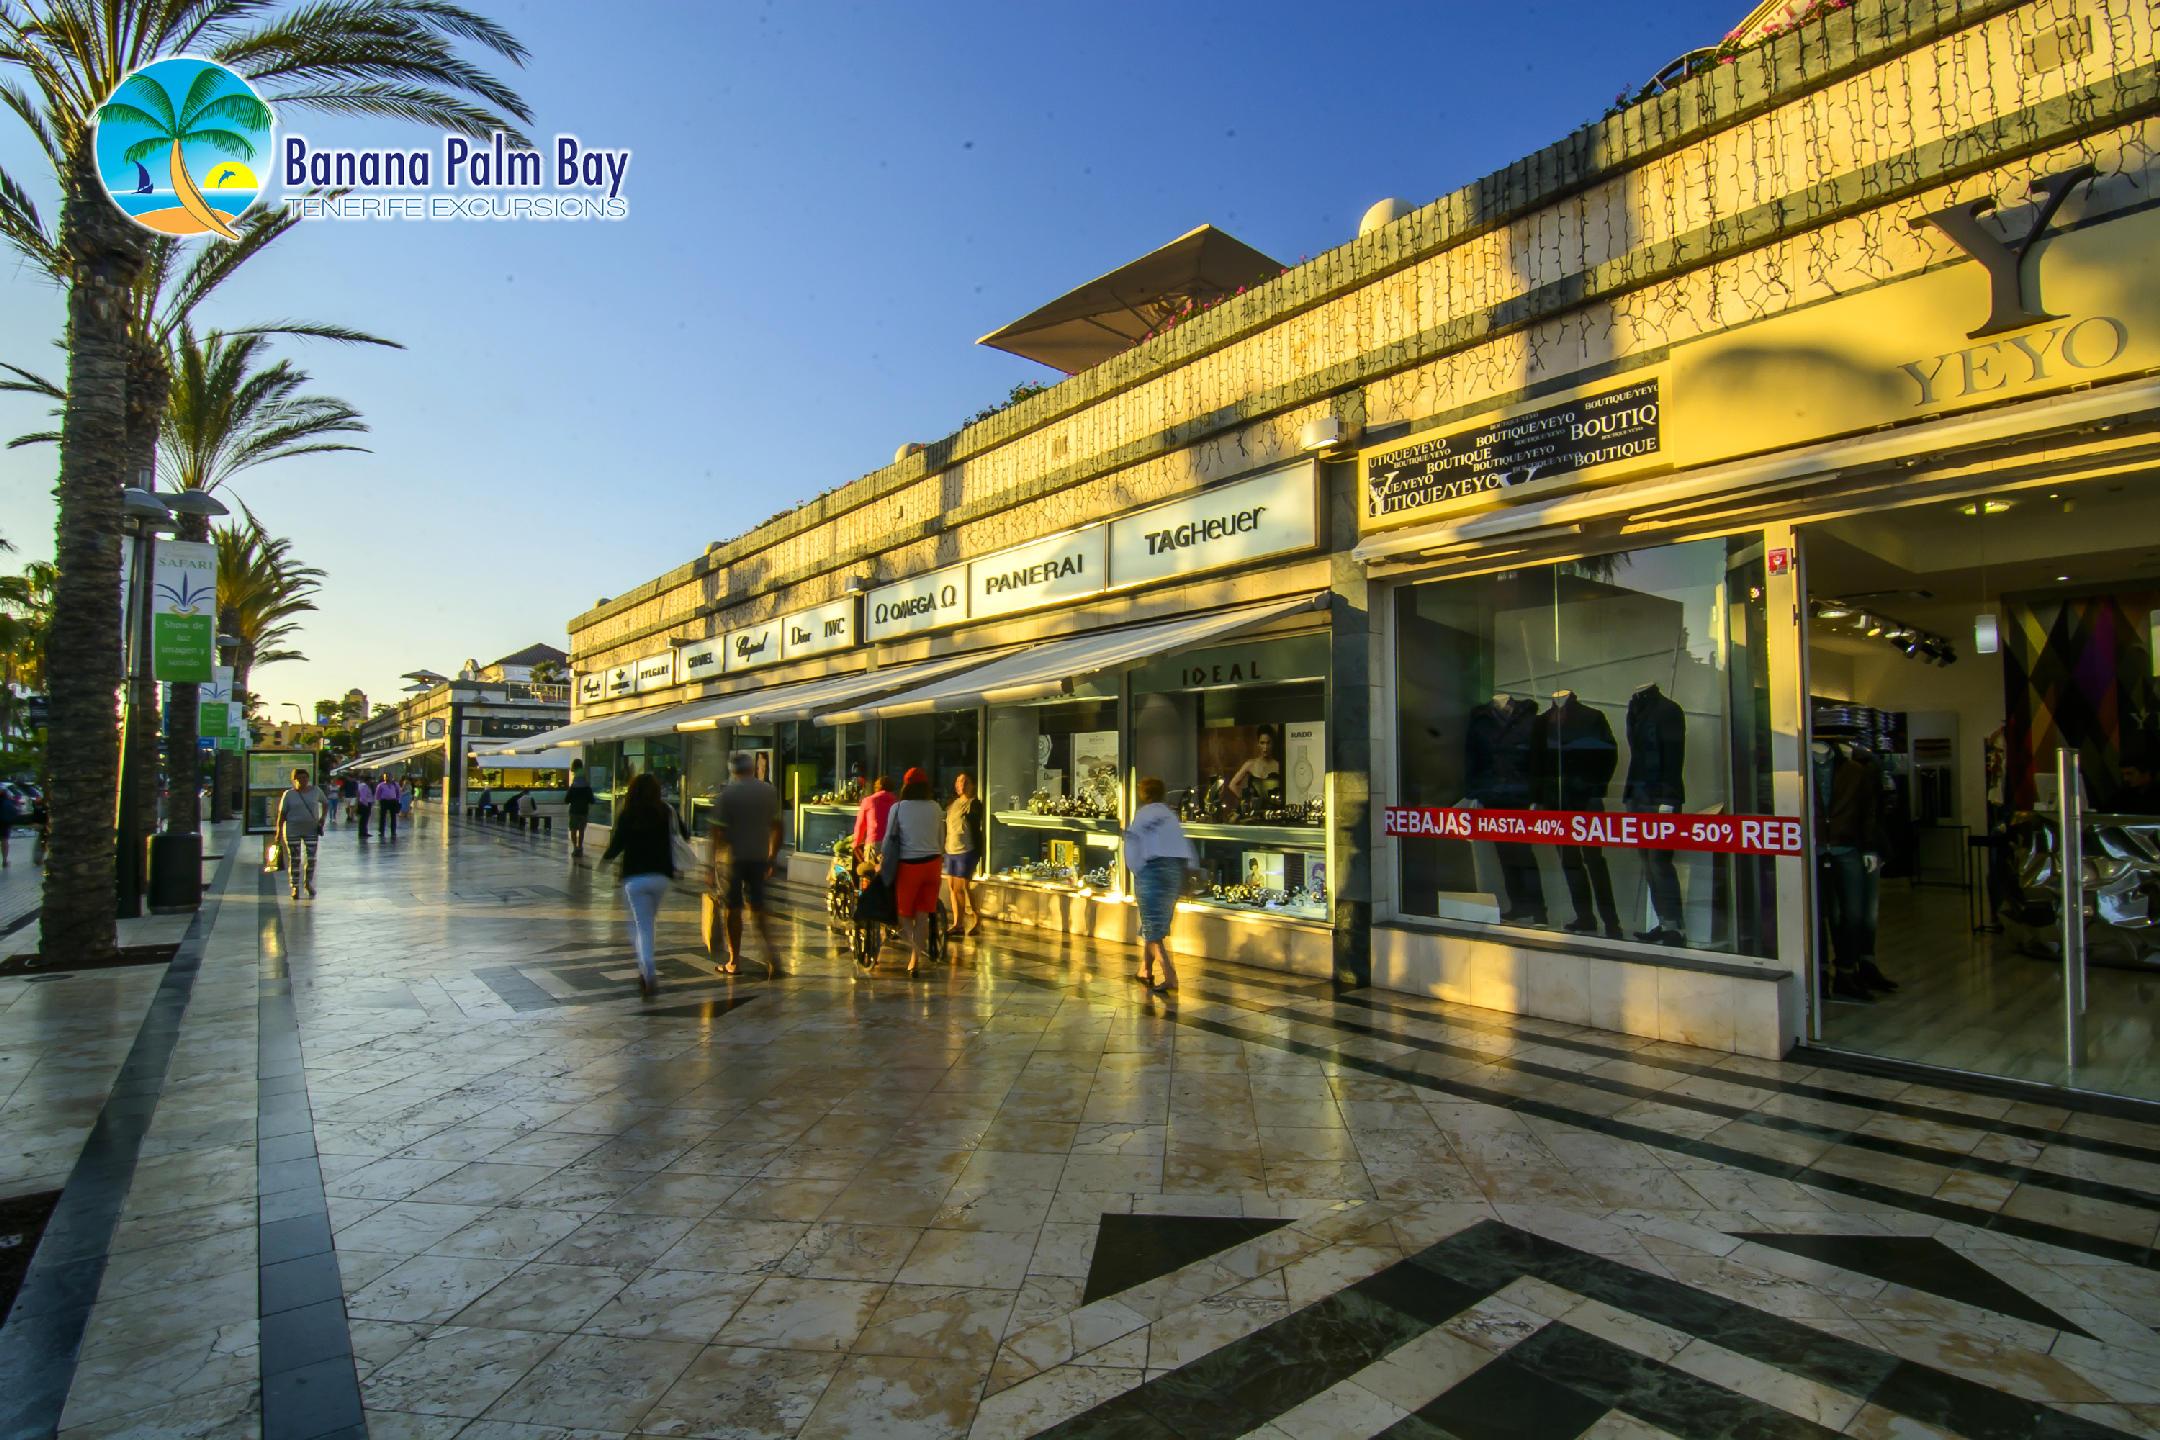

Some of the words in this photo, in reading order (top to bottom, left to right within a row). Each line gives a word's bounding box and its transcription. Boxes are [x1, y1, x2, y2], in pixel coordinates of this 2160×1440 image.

[1897, 316, 2129, 407] YEYO
[1475, 412, 1575, 448] BOUTIQUE/YEYO
[1426, 447, 1492, 475] BOUTIQUE
[1574, 437, 1657, 468] BOUTIQUE
[159, 558, 213, 570] SAFARI
[985, 553, 1083, 595] PANERAI
[890, 591, 937, 620] OMEGA
[824, 617, 845, 638] IWC
[1182, 660, 1262, 687] IDEAL
[1384, 810, 1472, 836] REBAJAS
[1478, 817, 1526, 834] HASTA
[1527, 818, 1565, 836] -40%
[1571, 815, 1639, 844] SALE
[1641, 821, 1675, 840] UP
[1741, 820, 1802, 850] REB
